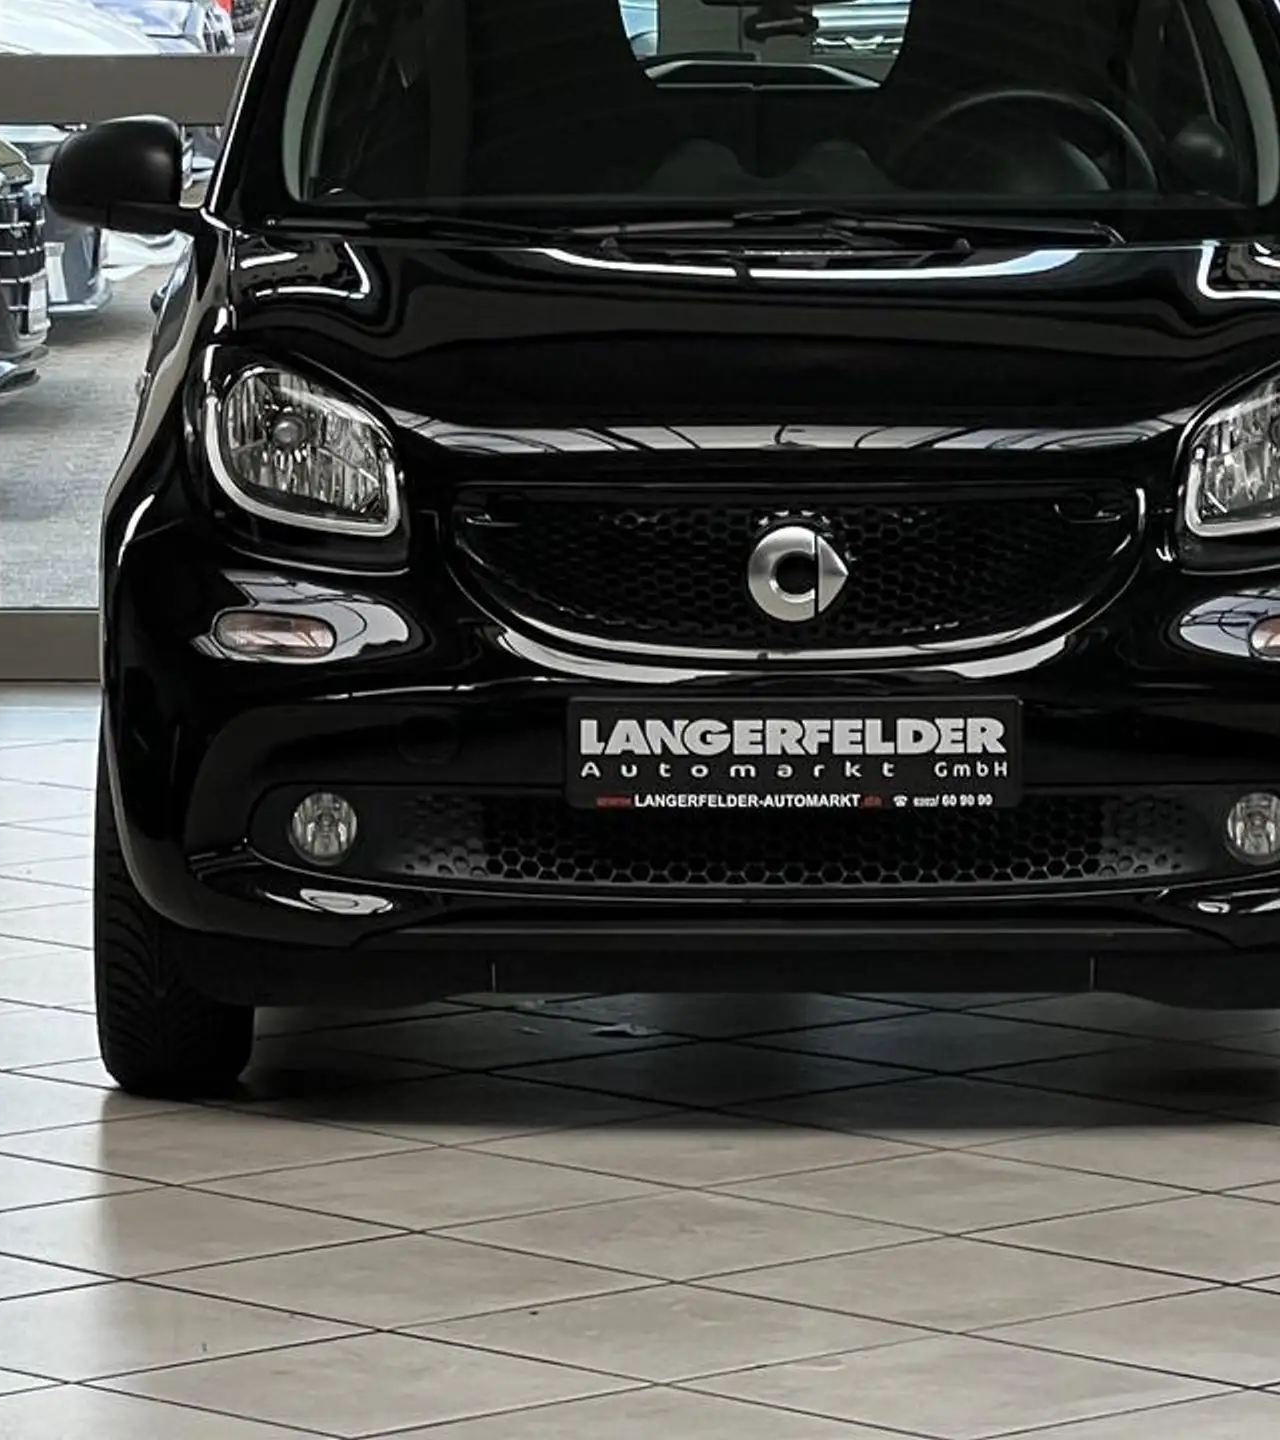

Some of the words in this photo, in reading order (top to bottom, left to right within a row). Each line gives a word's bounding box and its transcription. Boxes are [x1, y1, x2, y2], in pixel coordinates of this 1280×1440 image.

[580, 717, 1007, 756] LANGERFELDER
[580, 760, 895, 778] Automarkt
[934, 760, 1008, 778] GmbH
